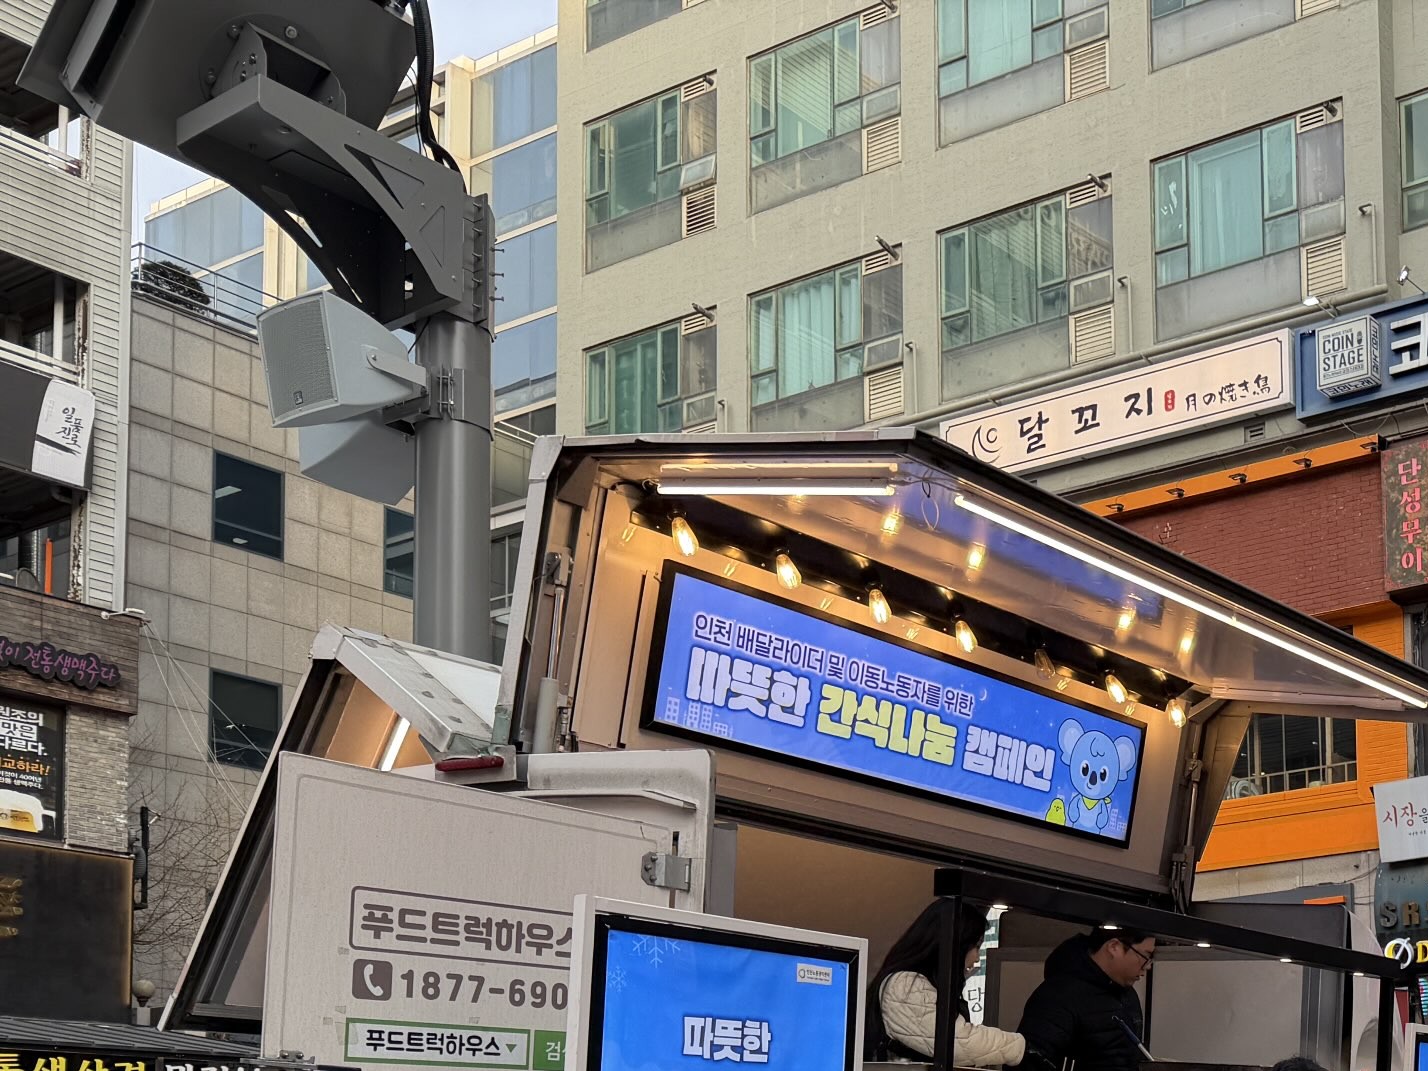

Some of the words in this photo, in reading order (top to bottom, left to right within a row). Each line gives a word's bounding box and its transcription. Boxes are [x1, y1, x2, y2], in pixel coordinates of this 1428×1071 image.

[1323, 333, 1354, 354] COIN
[1323, 348, 1364, 371] STAGE
[1398, 458, 1423, 572] 단성무이
[693, 613, 732, 648] 인천
[735, 626, 824, 674] 배달라이더
[829, 654, 846, 681] 및
[848, 662, 942, 709] 이동노동자를
[943, 688, 975, 719] 위한
[685, 646, 811, 728] 따뜻한
[816, 685, 958, 767] 간식나눔
[962, 725, 1057, 793] 캠페인
[0, 758, 51, 776] 교하라!
[366, 1029, 501, 1056] 푸드트럭하우스
[682, 1015, 771, 1063] 따뜻한
